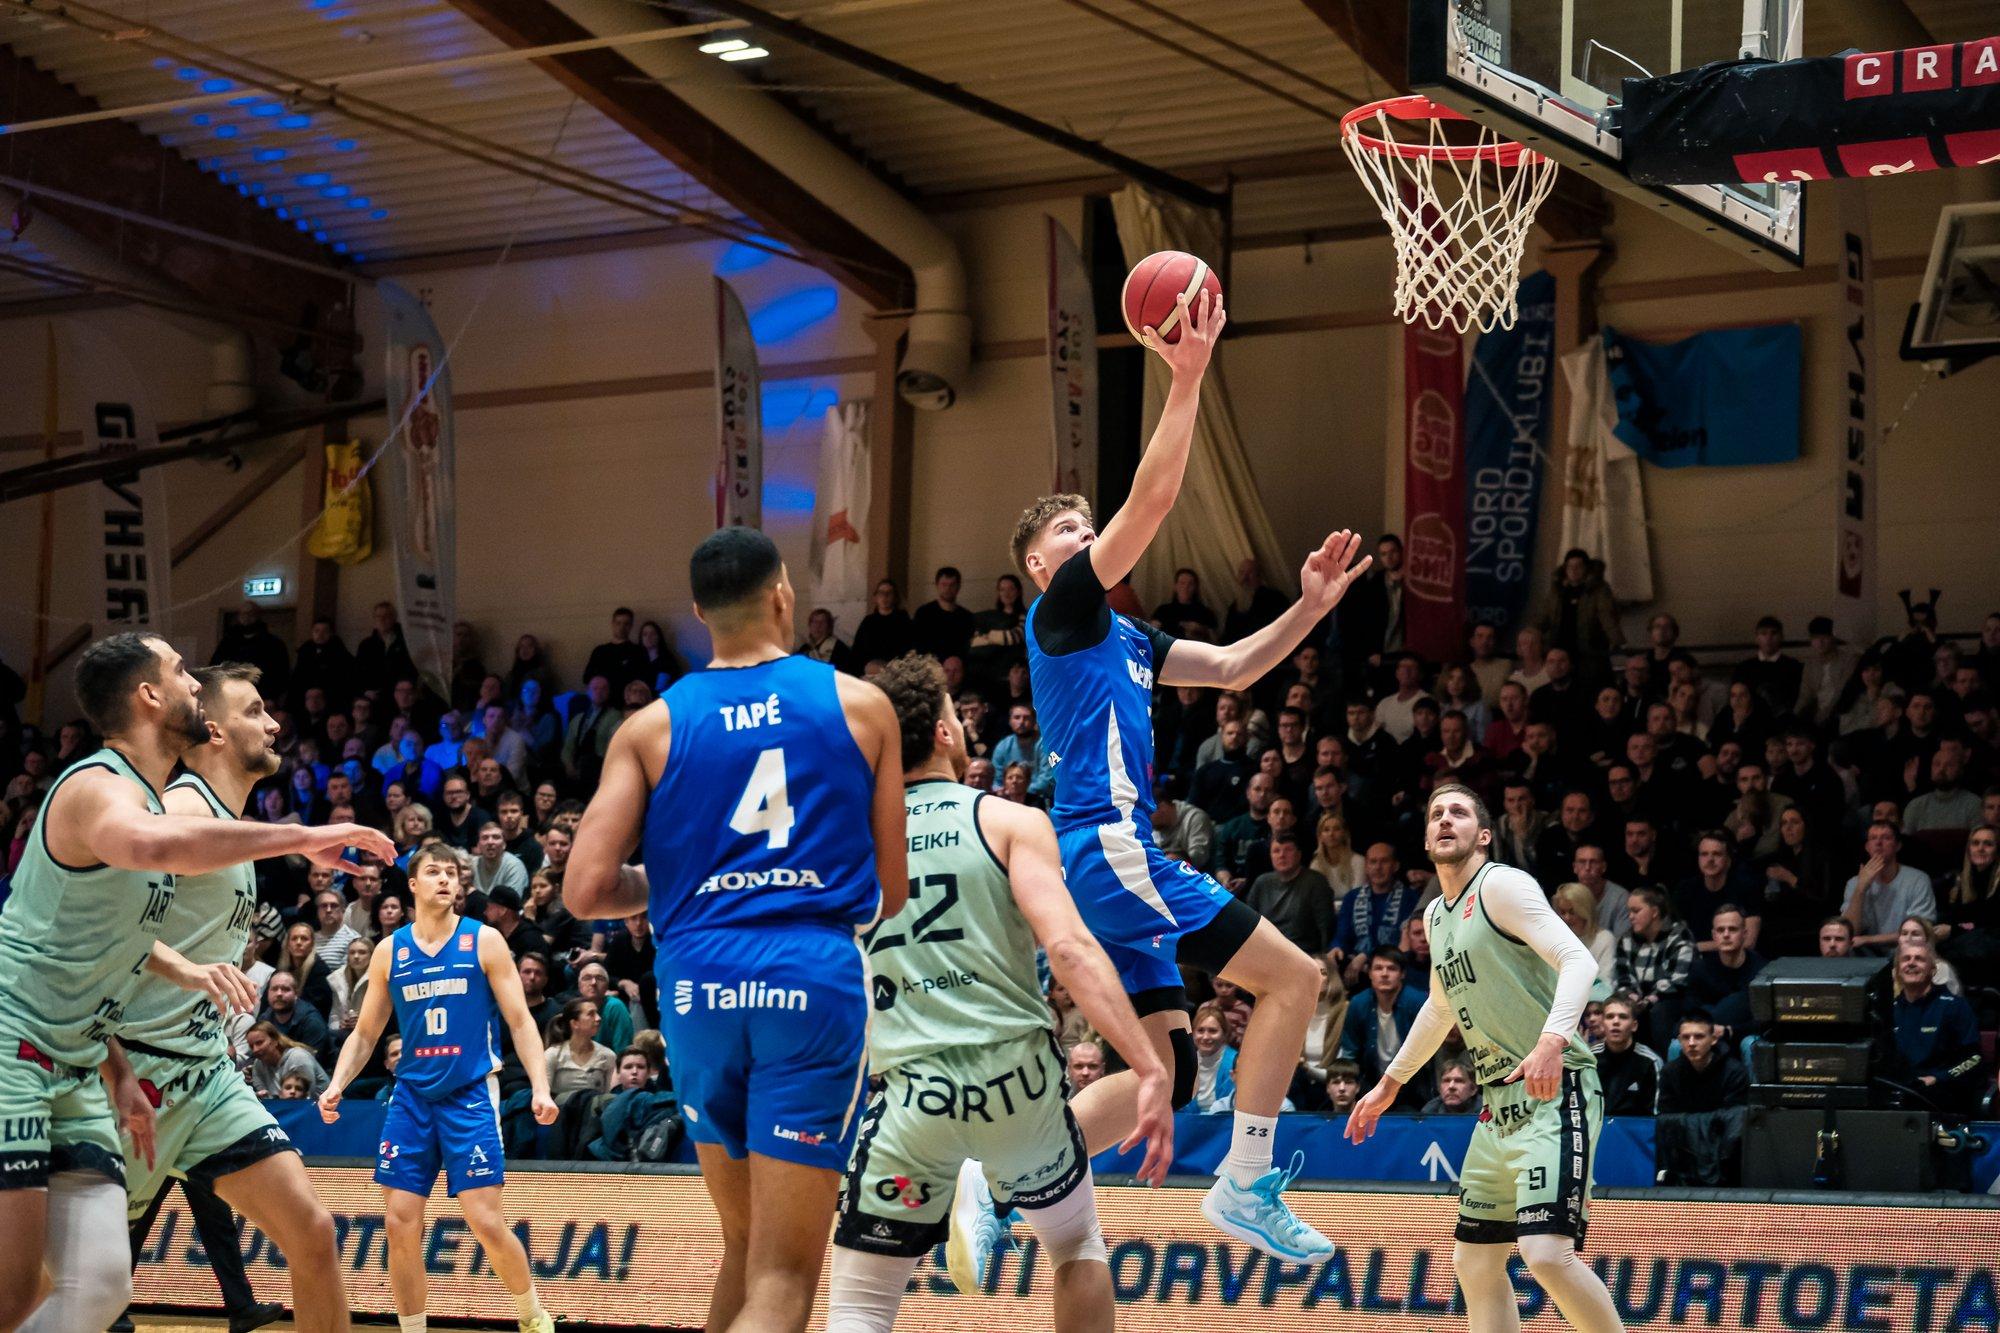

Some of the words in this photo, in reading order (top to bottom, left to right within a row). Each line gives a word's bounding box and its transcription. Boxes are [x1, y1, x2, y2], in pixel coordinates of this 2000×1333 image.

[719, 693, 782, 732] TAPÉ
[729, 748, 796, 850] 4
[907, 831, 960, 853] EIKH
[695, 867, 825, 896] HONDA
[701, 981, 808, 1012] Tallinn
[424, 1007, 448, 1036] 10
[1458, 1006, 1474, 1031] 9
[4, 1116, 46, 1142] LUX
[1246, 1125, 1269, 1138] 23
[1466, 1198, 1496, 1210] Express
